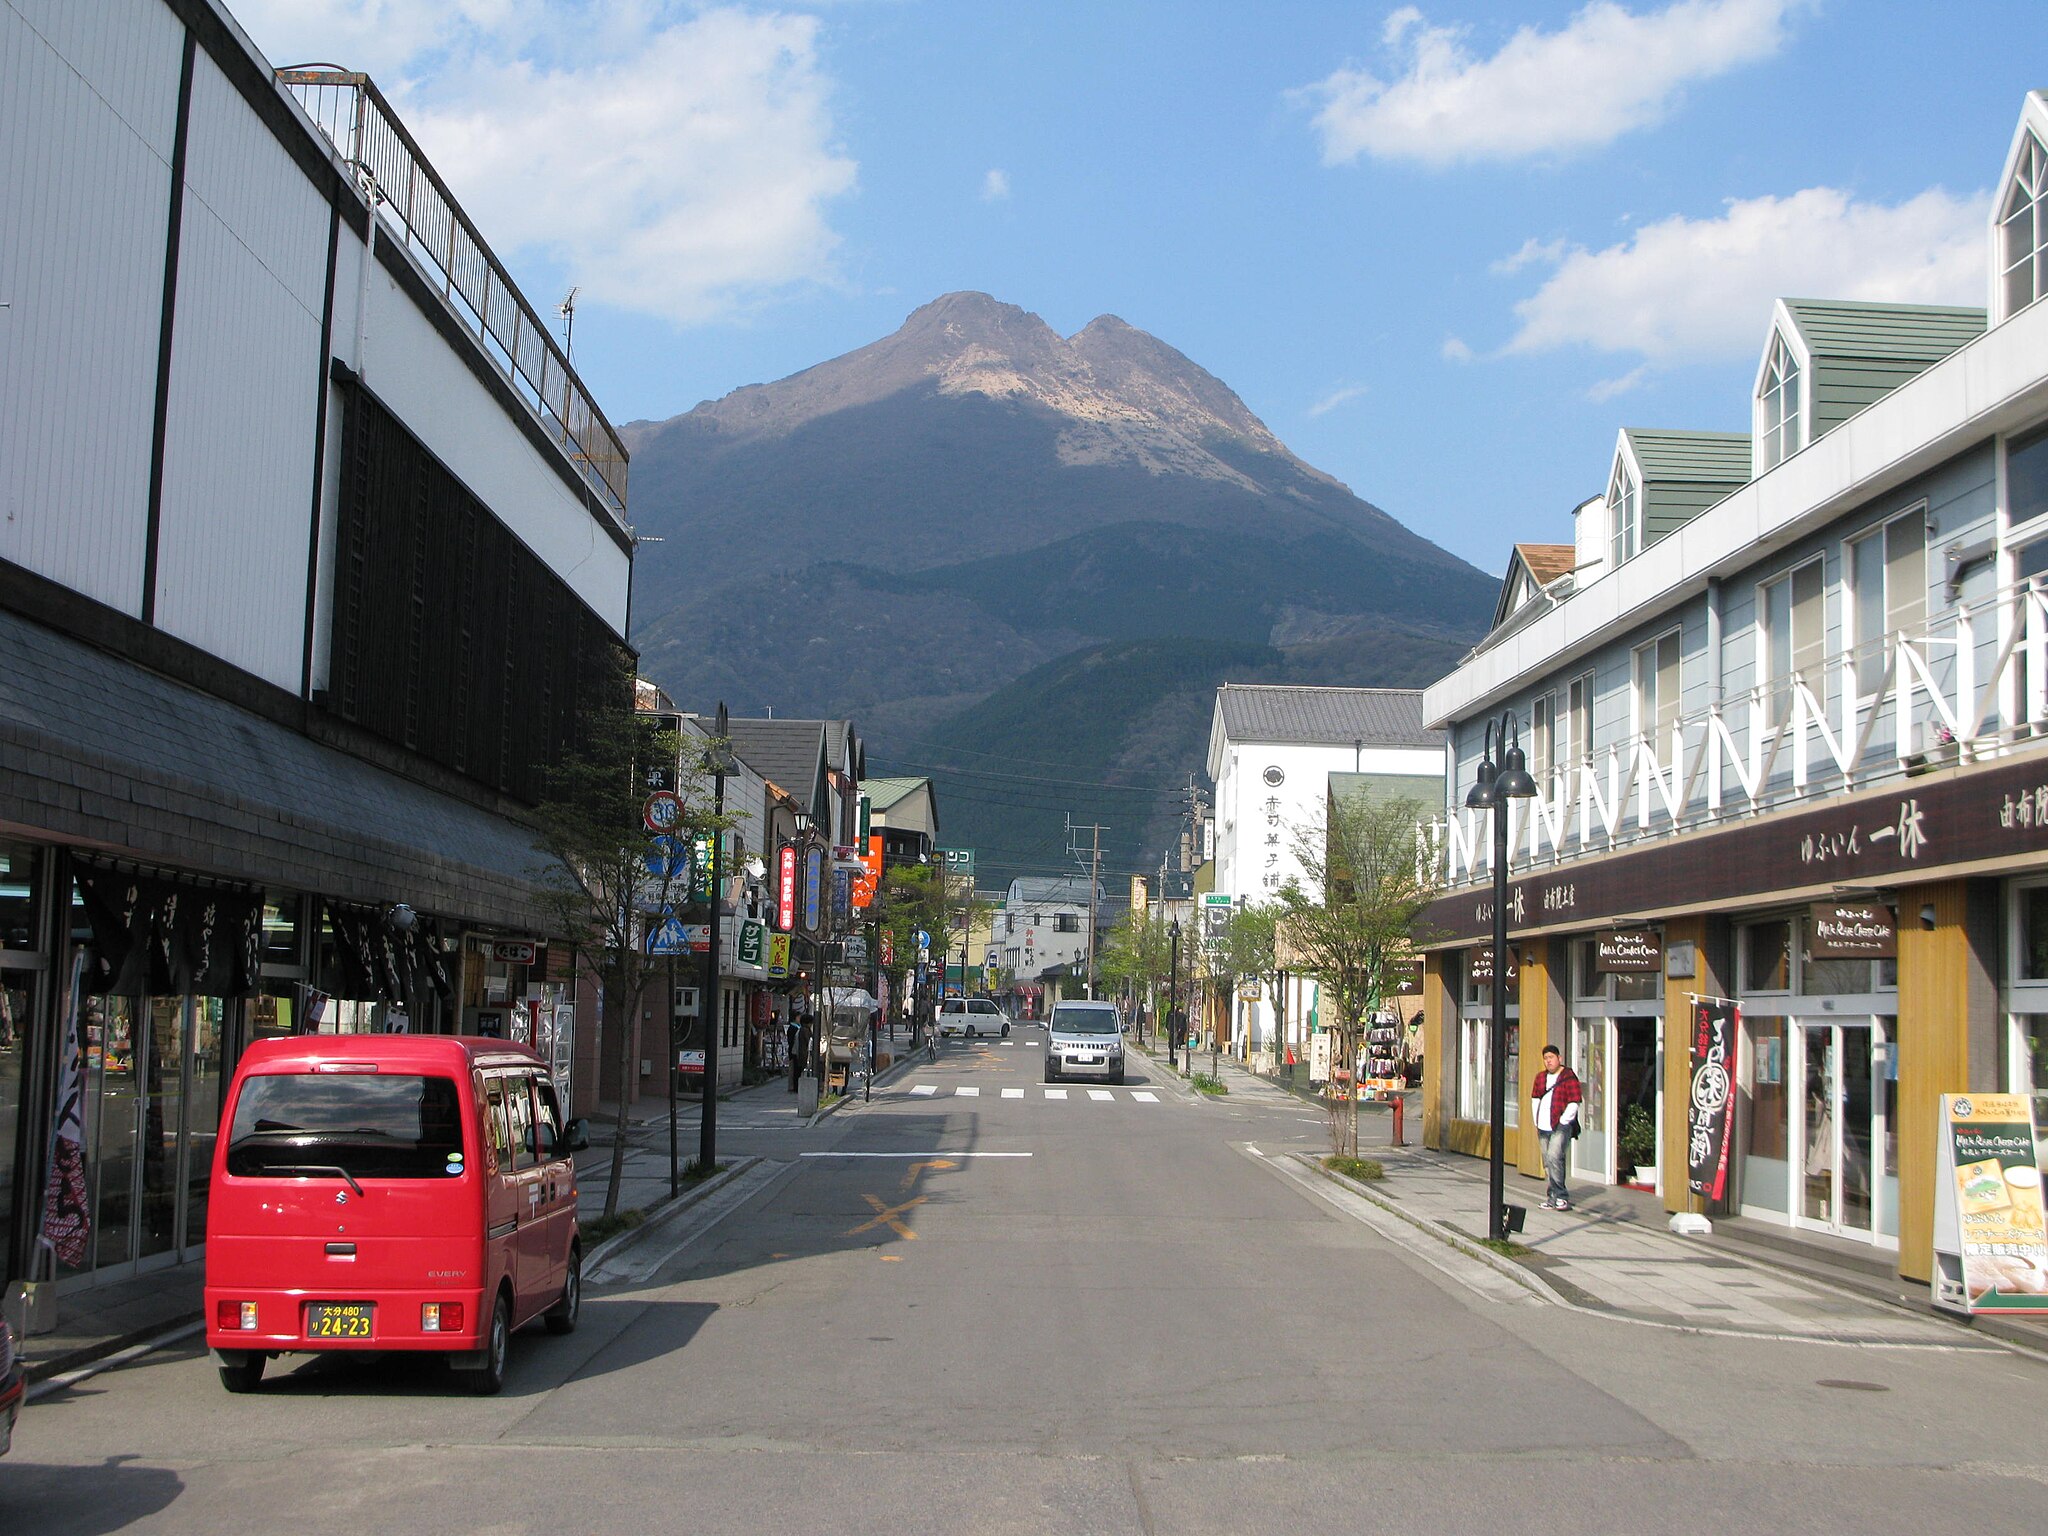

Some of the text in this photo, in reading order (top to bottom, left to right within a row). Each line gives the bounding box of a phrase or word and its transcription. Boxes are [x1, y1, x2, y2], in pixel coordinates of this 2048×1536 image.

[1801, 800, 1928, 864] ゆふいん 一休
[1475, 903, 1494, 922] ゆふい
[499, 945, 528, 958] たばこ
[743, 925, 760, 960] サチコ
[1963, 1213, 2005, 1224] ゆふいん
[1964, 1228, 2045, 1240] レアチーズケーキ
[321, 1317, 369, 1336] 24-23
